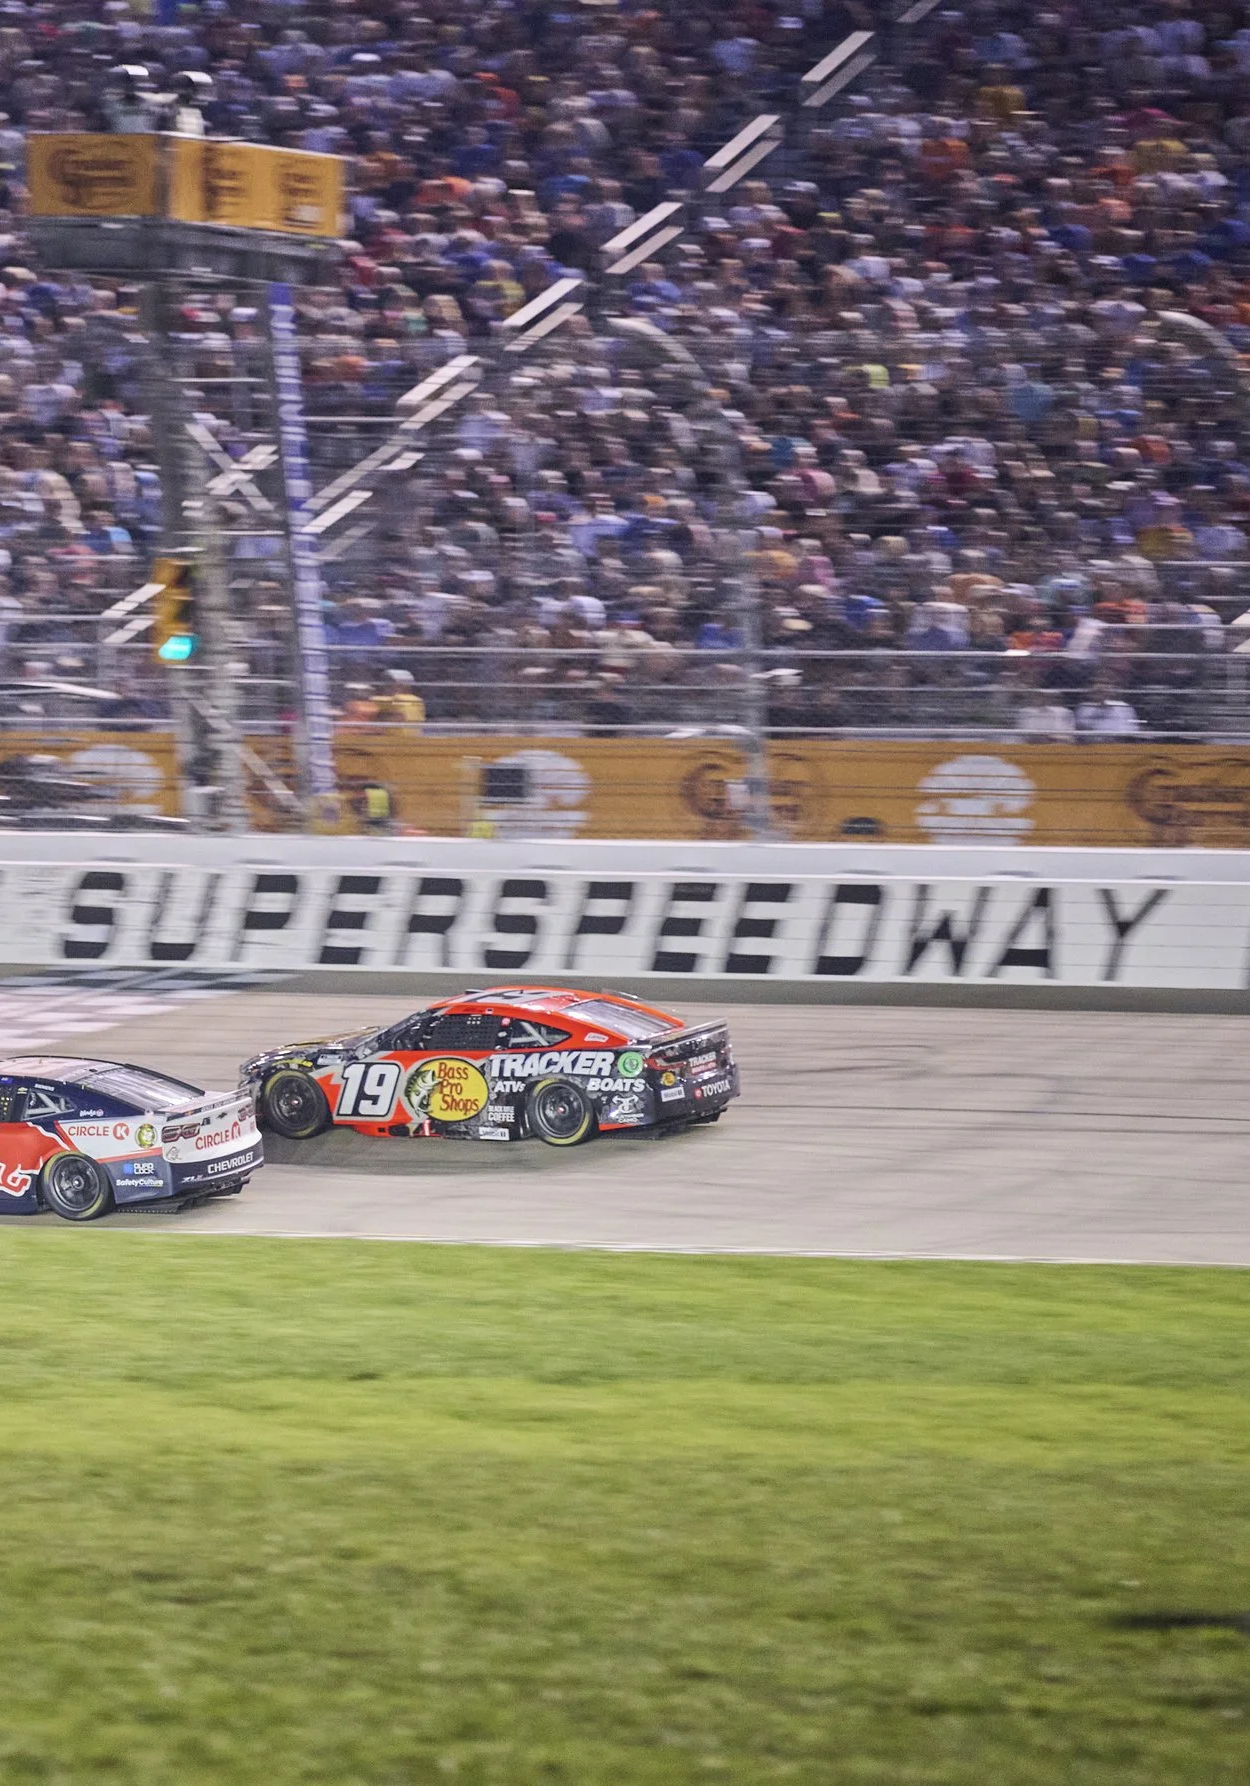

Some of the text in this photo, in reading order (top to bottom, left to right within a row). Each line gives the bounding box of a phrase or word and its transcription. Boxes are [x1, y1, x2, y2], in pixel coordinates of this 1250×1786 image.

[58, 872, 1168, 981] SUPERSPEEDWAY
[437, 1062, 469, 1079] Bass
[489, 1051, 615, 1077] TRACKER
[338, 1062, 400, 1116] 19
[439, 1079, 463, 1095] Pro
[494, 1081, 526, 1093] ATVs
[587, 1078, 646, 1092] BOATS
[701, 1080, 731, 1097] TOYOTA
[440, 1094, 479, 1116] Shops
[488, 1113, 515, 1123] COFFEE
[68, 1126, 110, 1136] CIRCLE
[116, 1125, 129, 1138] K
[195, 1129, 230, 1150] CIRCLE
[207, 1151, 254, 1174] CHEVROLET
[116, 1179, 164, 1187] SafetyCulture
